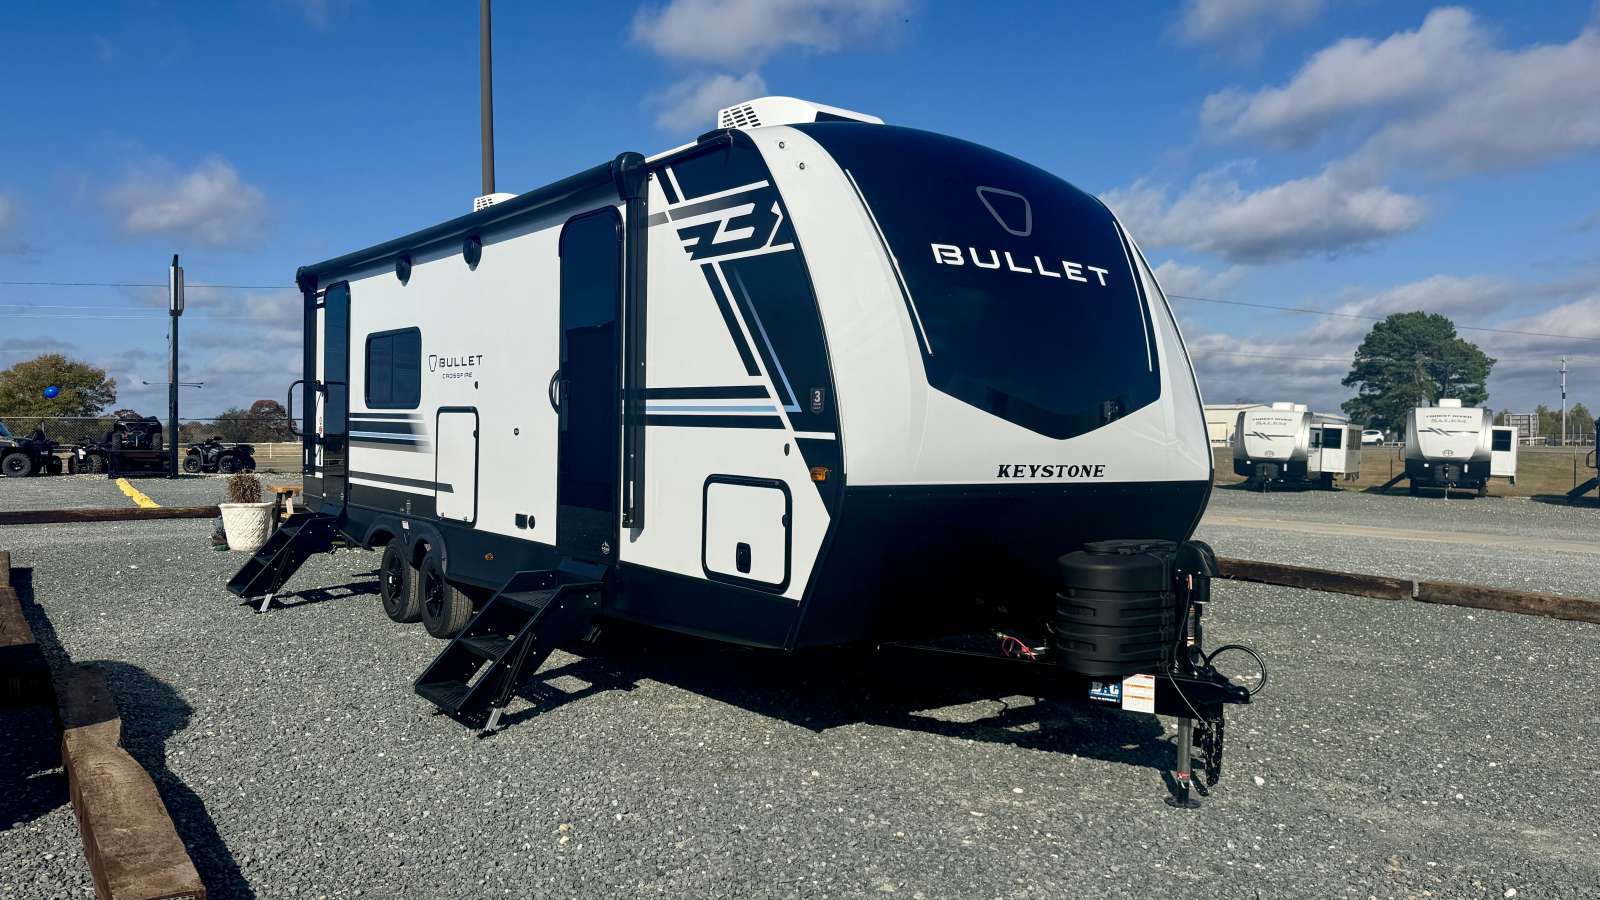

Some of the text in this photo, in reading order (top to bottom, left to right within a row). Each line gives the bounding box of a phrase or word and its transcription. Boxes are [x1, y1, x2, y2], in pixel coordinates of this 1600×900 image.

[931, 243, 1109, 287] BULLET
[439, 355, 483, 368] BULLET
[814, 390, 821, 403] 3
[997, 464, 1106, 478] KEYSTONE
